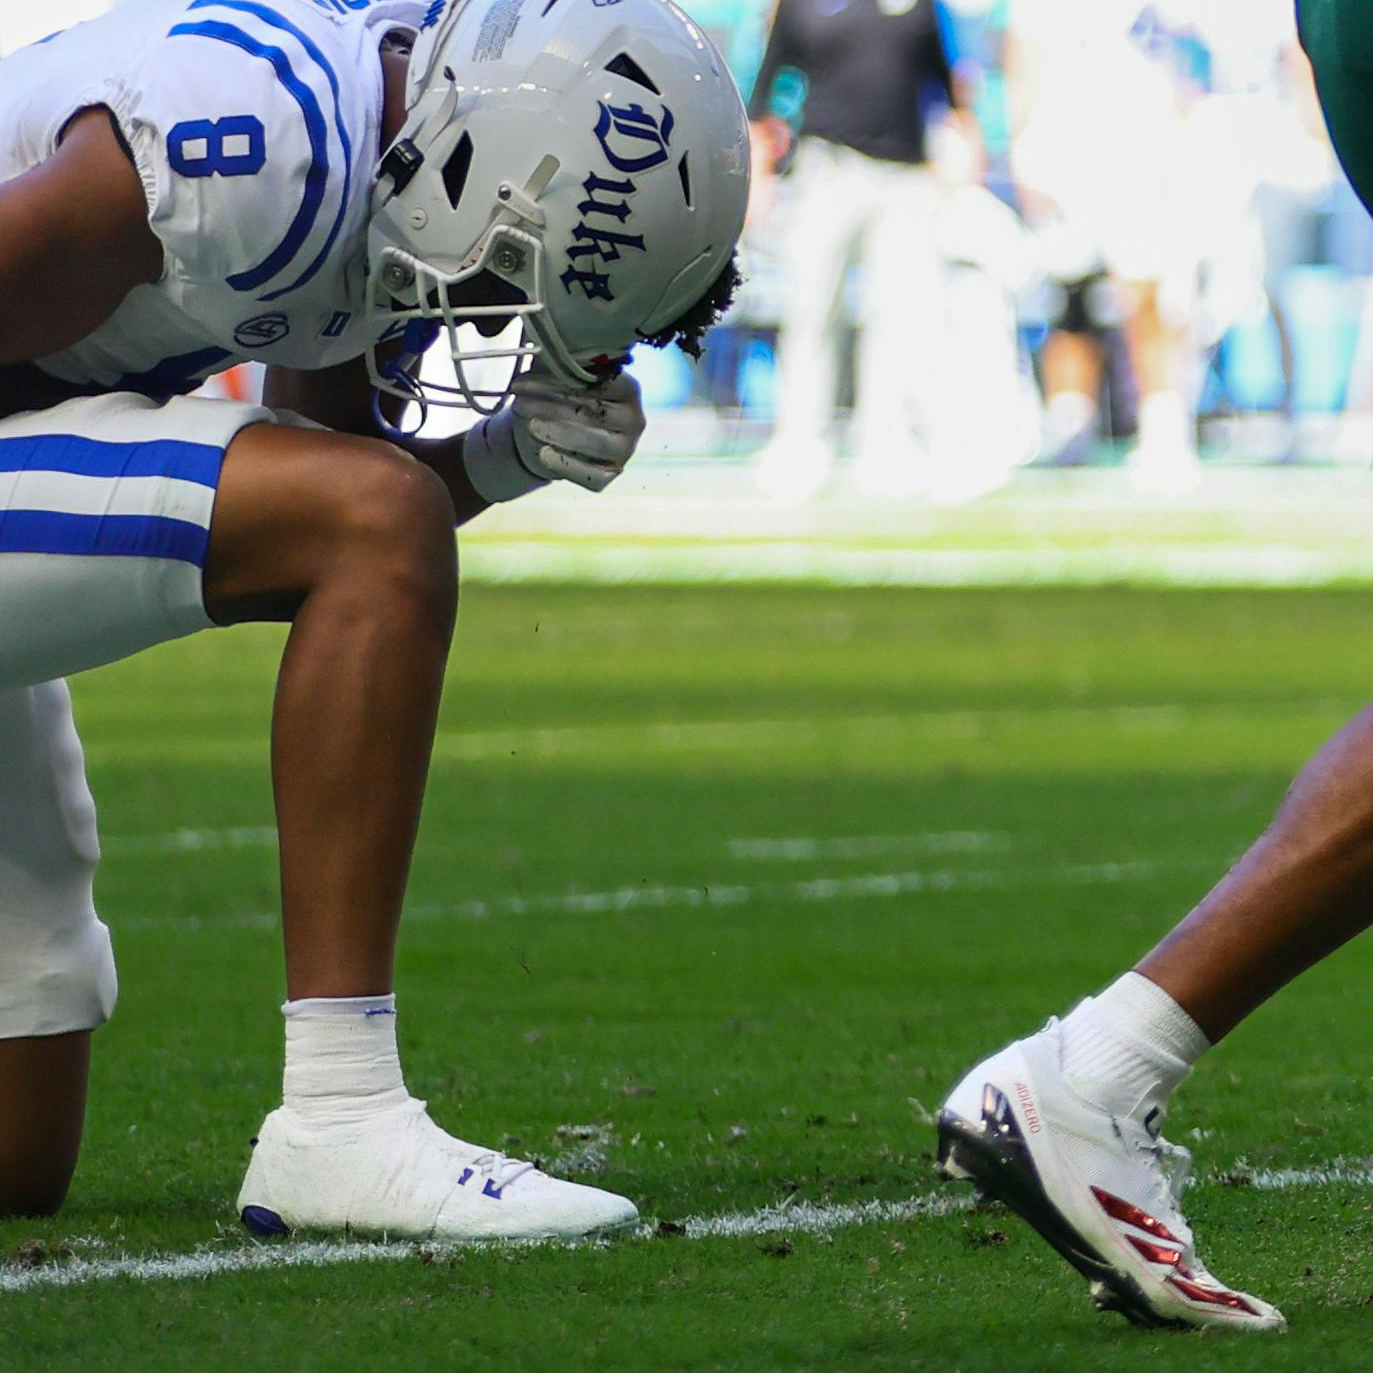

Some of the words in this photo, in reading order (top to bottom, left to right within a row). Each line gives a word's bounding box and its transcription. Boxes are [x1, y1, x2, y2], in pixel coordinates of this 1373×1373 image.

[166, 114, 267, 178] 8
[559, 99, 675, 302] Duke
[1015, 1081, 1041, 1135] ADIZERO
